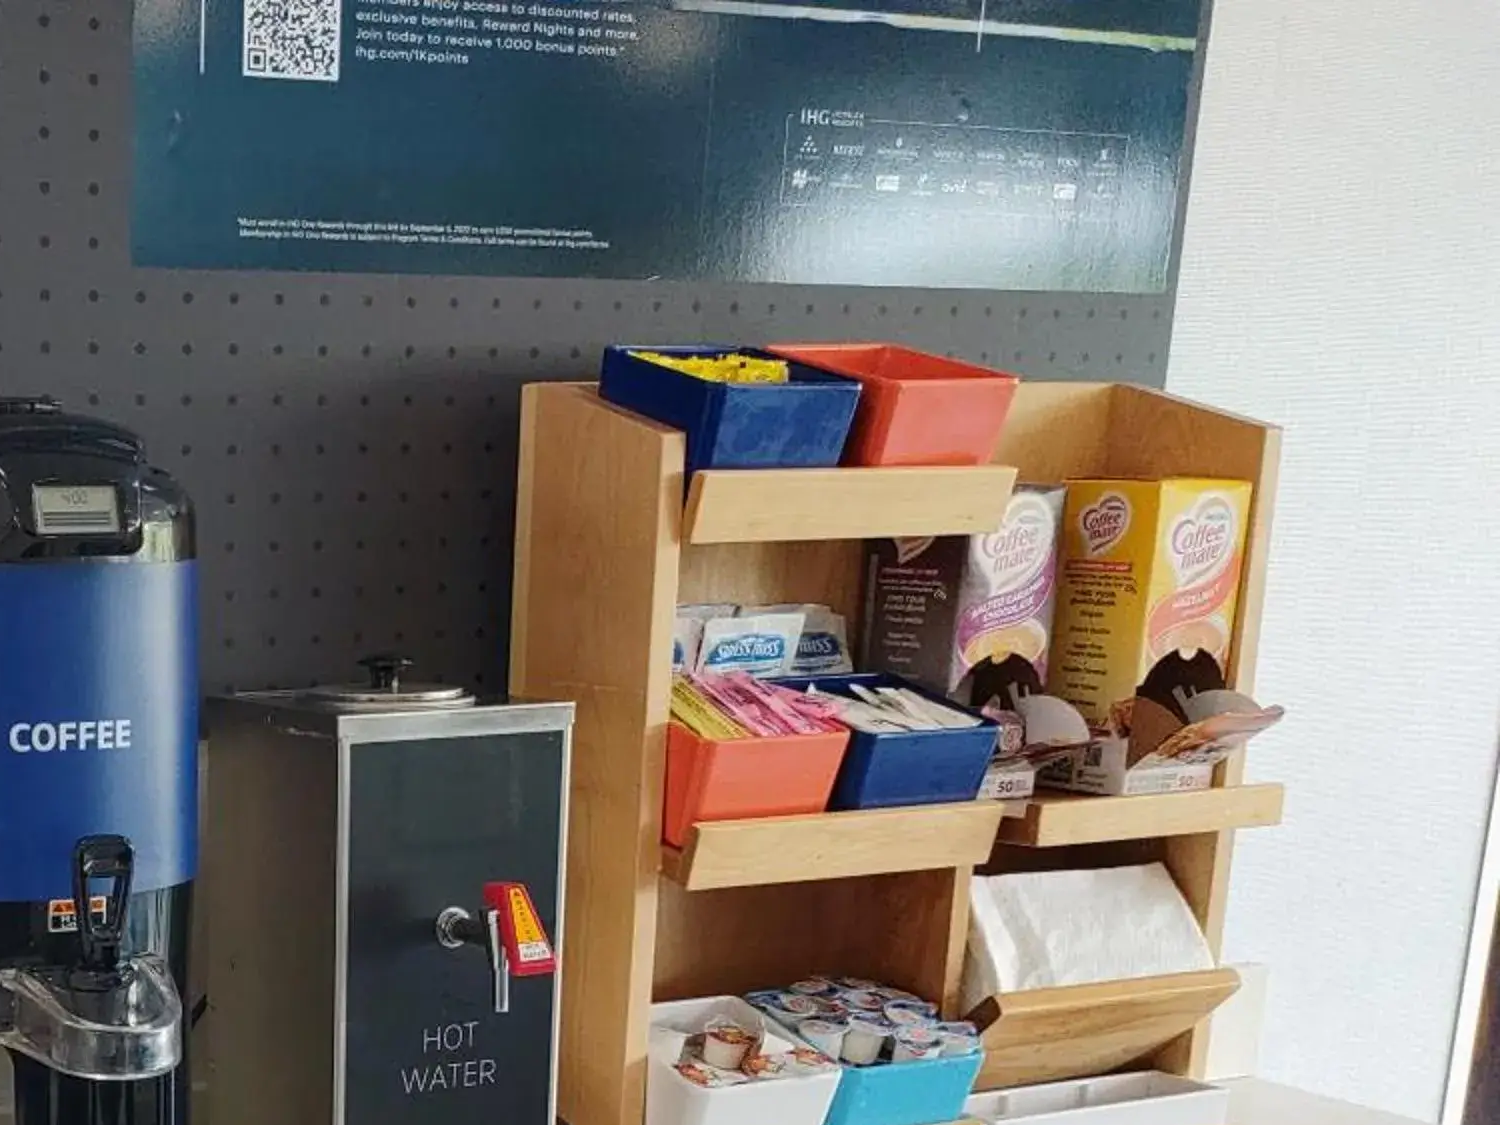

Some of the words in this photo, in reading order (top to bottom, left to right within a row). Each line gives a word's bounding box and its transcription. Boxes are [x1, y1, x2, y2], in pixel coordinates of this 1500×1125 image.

[356, 10, 418, 25] exclusive
[483, 18, 531, 33] Reward
[534, 22, 575, 37] Nights
[577, 26, 601, 38] and
[463, 2, 508, 13] access
[512, 4, 525, 15] to
[527, 4, 599, 20] discounted
[356, 27, 383, 40] Join
[386, 30, 424, 45] today
[427, 33, 441, 45] to
[445, 35, 493, 49] receive
[535, 40, 575, 53] bonus
[800, 107, 830, 126] IHG
[9, 719, 132, 753] COFFEE
[997, 781, 1013, 793] 50
[422, 1021, 479, 1053] HOT
[401, 1059, 497, 1094] WATER
